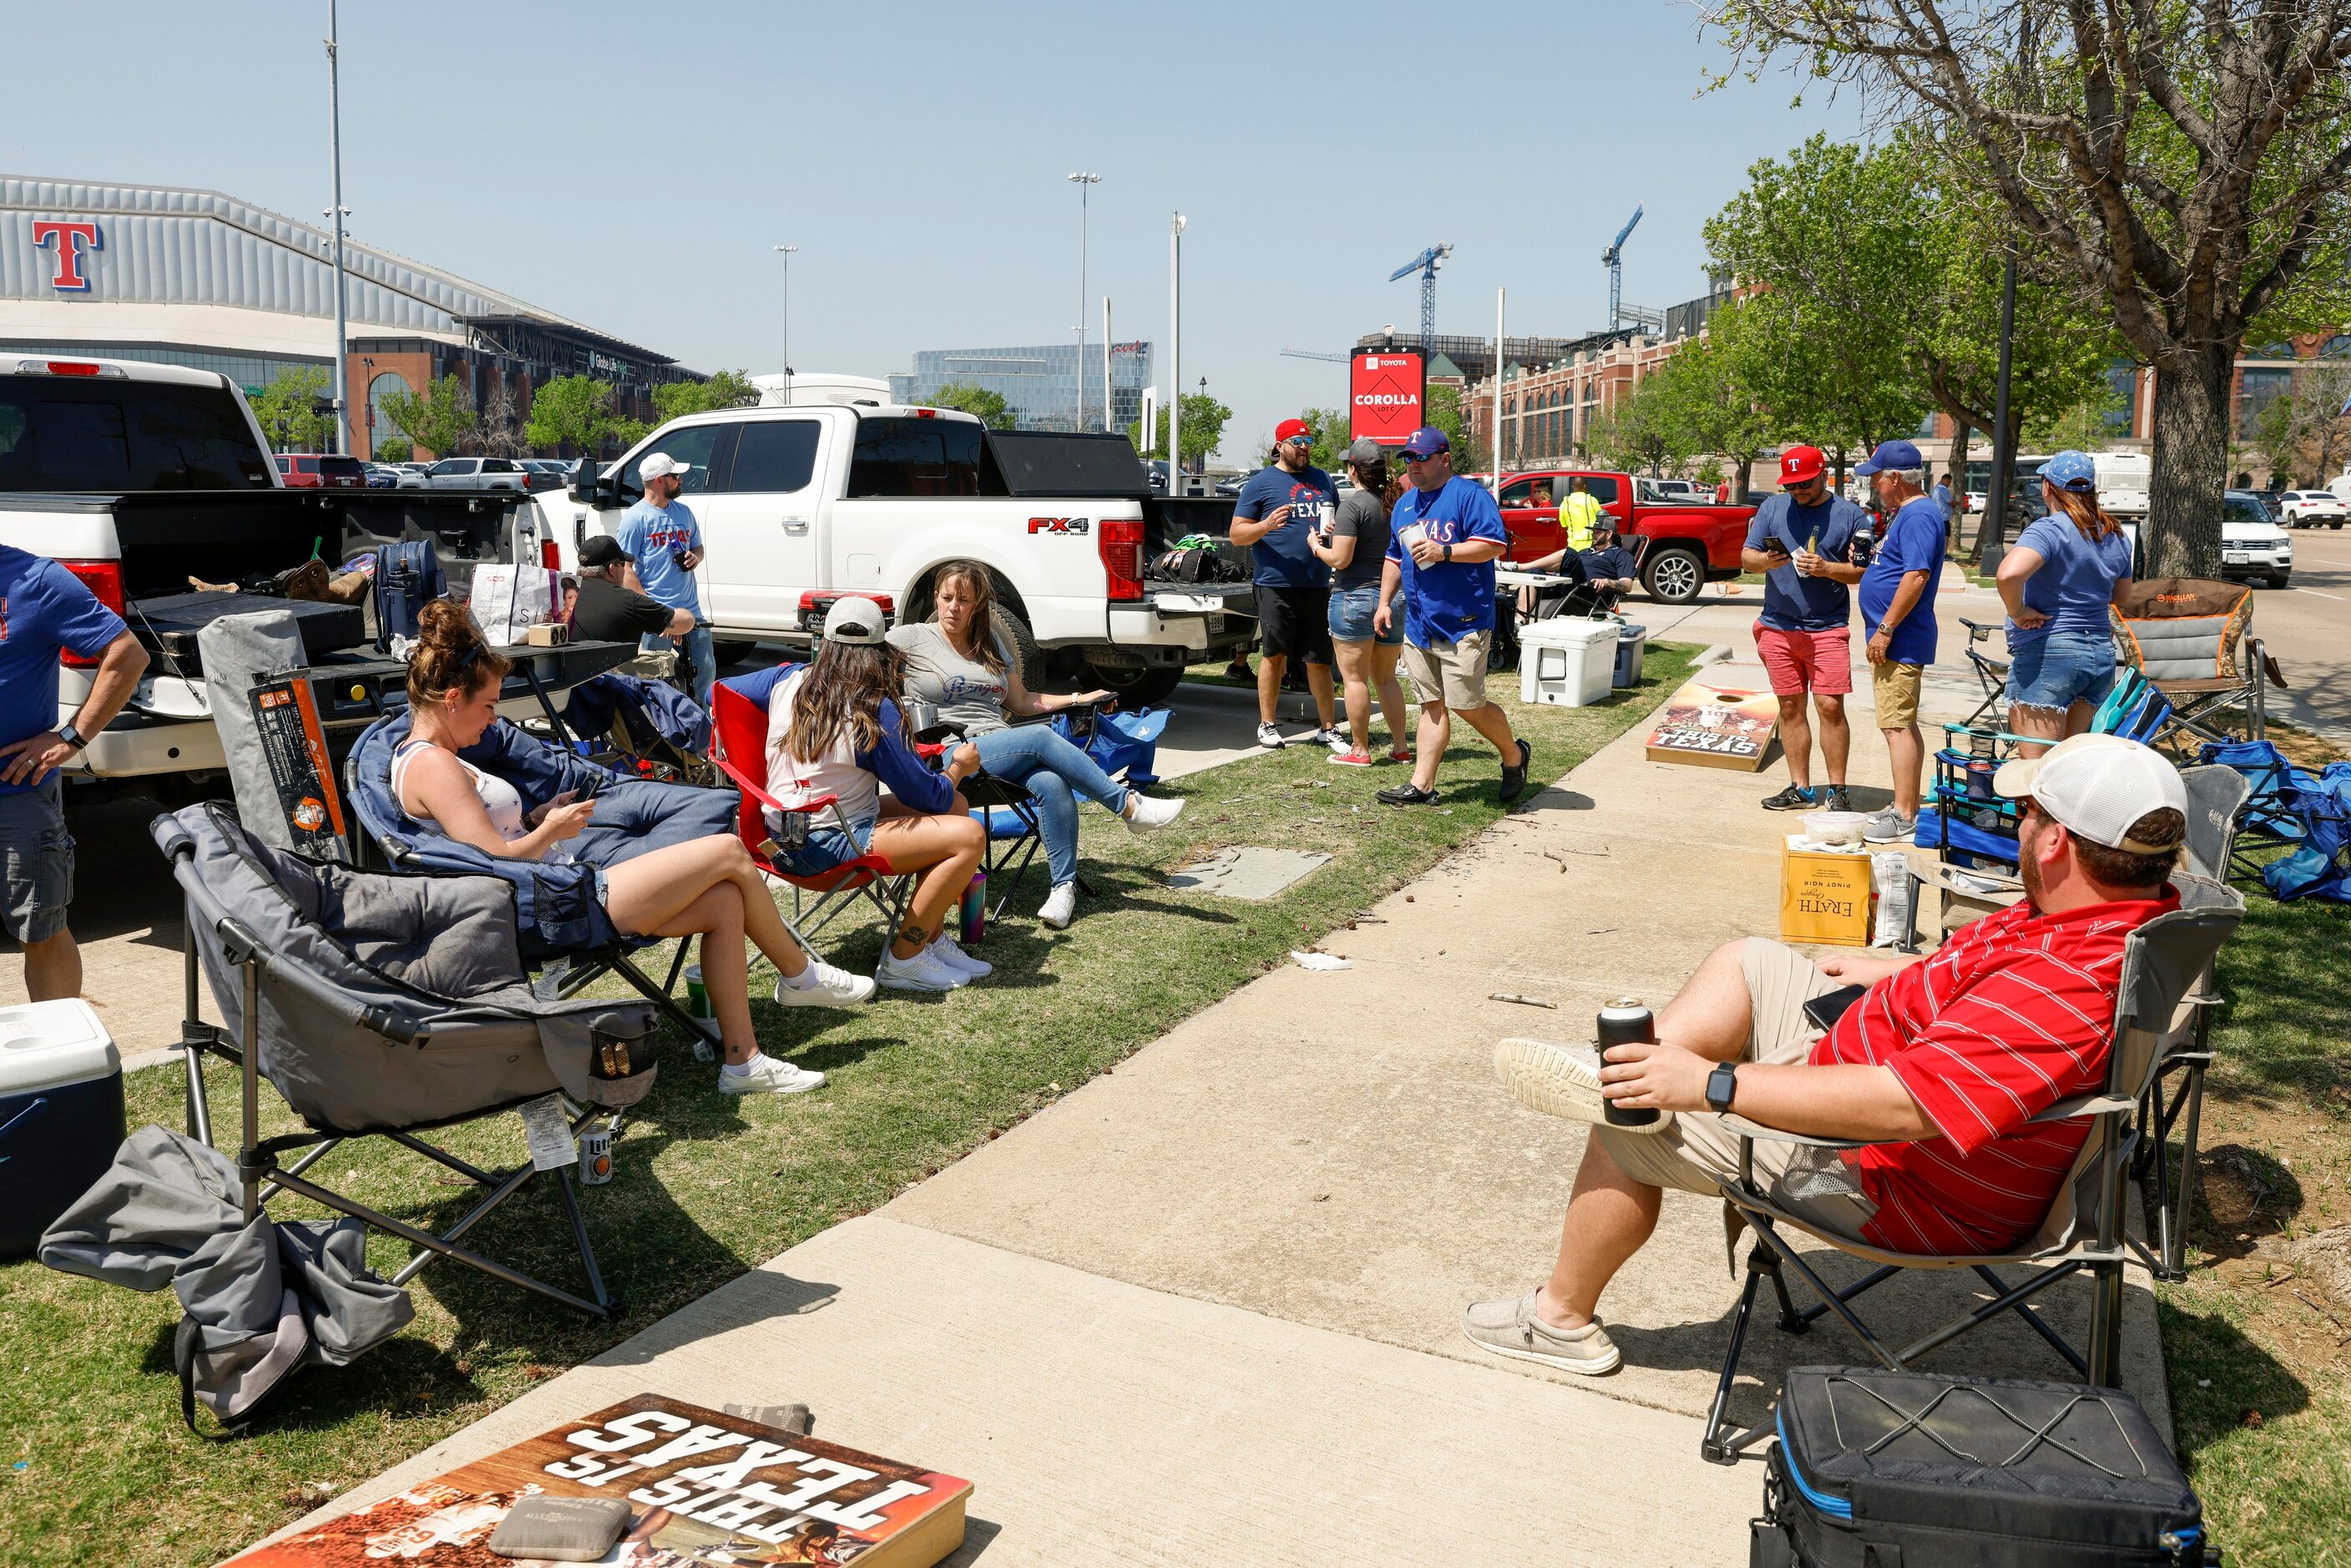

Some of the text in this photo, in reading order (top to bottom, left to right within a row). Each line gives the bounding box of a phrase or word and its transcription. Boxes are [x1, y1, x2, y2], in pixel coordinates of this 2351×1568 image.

[32, 220, 101, 291] T
[595, 353, 609, 370] Globe
[1355, 394, 1418, 405] COROLLA
[1411, 431, 1422, 443] T
[1788, 458, 1800, 472] T
[1289, 501, 1321, 518] TEXA
[1028, 517, 1089, 534] FX4
[1398, 518, 1456, 545] XAS
[2166, 593, 2195, 601] MAGELLAN
[943, 675, 1007, 701] Ranger
[1654, 733, 1757, 754] TEXAS
[1671, 729, 1722, 741] THIS
[1801, 888, 1825, 900] Oregon
[1799, 899, 1853, 917] ERATH
[544, 1449, 647, 1487] IS
[567, 1411, 932, 1530] TEXAS
[629, 1476, 811, 1545] THIS
